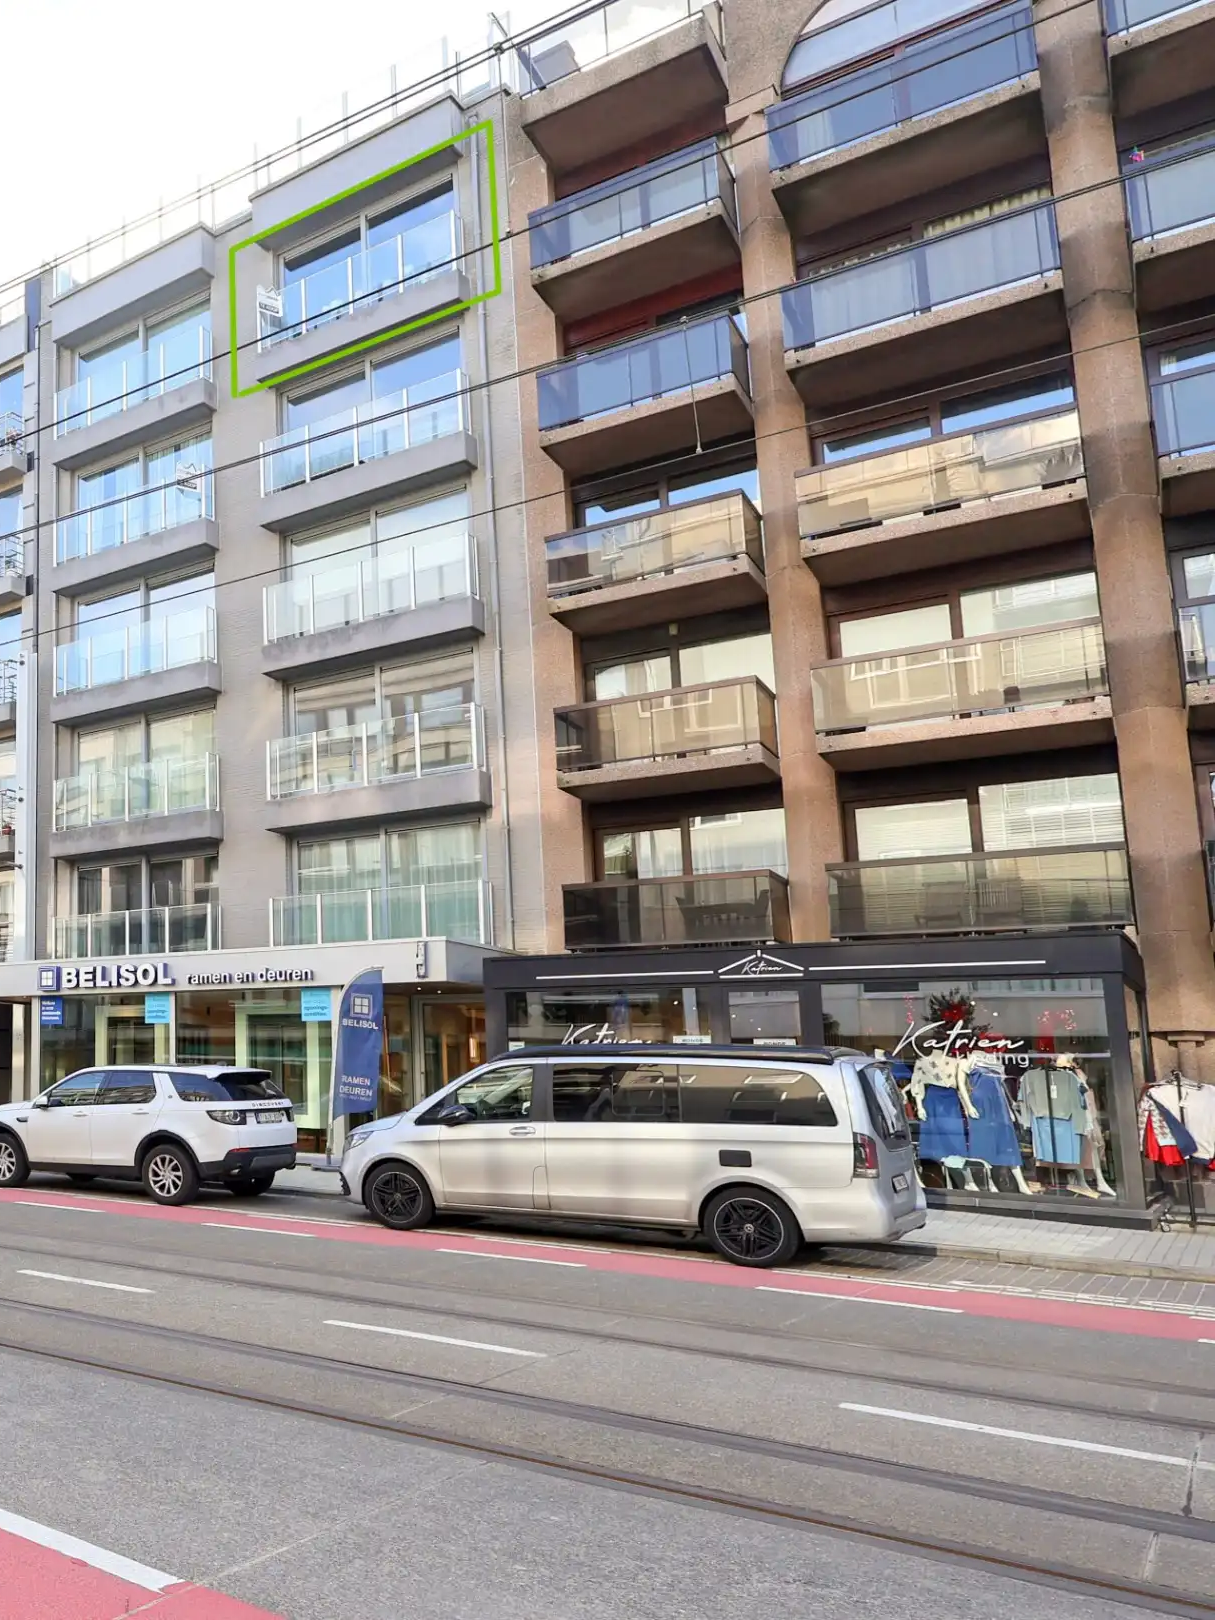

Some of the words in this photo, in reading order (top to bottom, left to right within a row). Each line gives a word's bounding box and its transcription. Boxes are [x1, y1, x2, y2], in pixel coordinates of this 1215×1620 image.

[61, 962, 174, 988] BELISOL
[741, 960, 783, 975] Katrien
[186, 971, 231, 984] ramen
[234, 970, 254, 982] en
[258, 967, 313, 981] deuren
[342, 1018, 379, 1030] BELISOL
[892, 1019, 1024, 1060] Katrien
[341, 1074, 370, 1086] RAMEN
[339, 1085, 373, 1097] DEUREN
